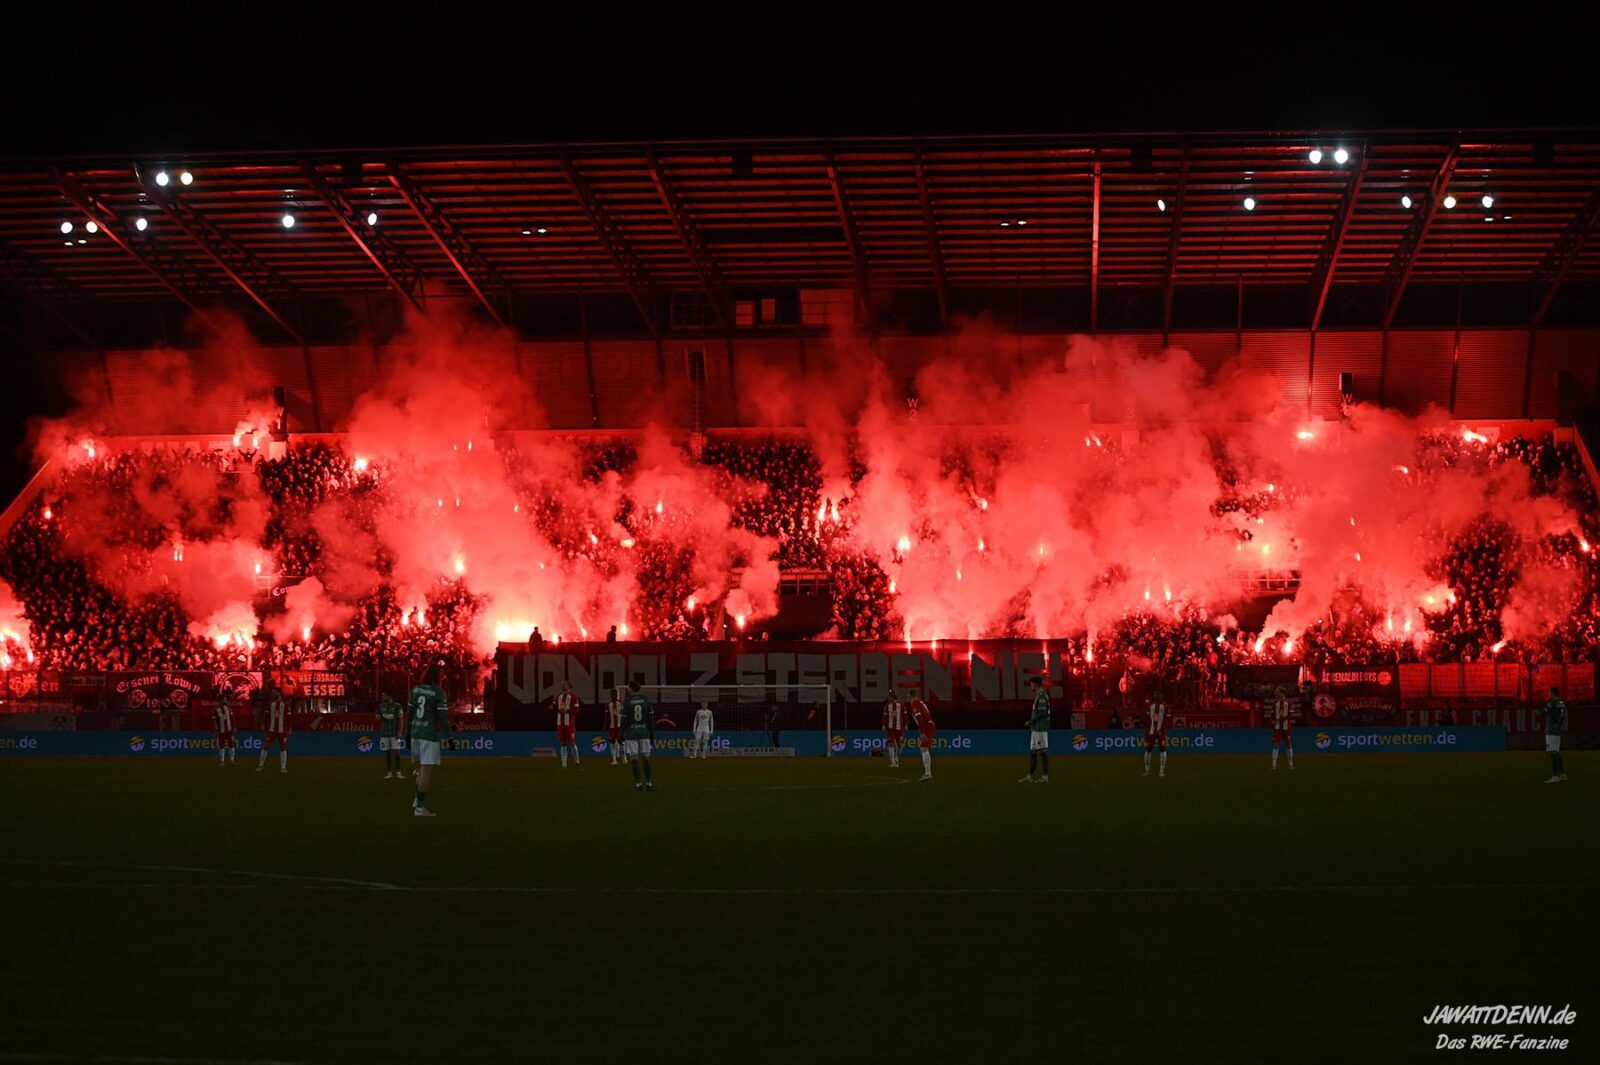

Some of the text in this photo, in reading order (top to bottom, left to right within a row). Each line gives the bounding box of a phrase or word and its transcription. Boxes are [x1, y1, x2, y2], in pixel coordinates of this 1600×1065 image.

[736, 652, 952, 703] STERBEN
[971, 651, 1064, 701] NIE!
[303, 684, 345, 697] ESSEN
[416, 695, 426, 719] 3
[634, 704, 643, 721] 8
[1338, 731, 1456, 746] sportwetten.de
